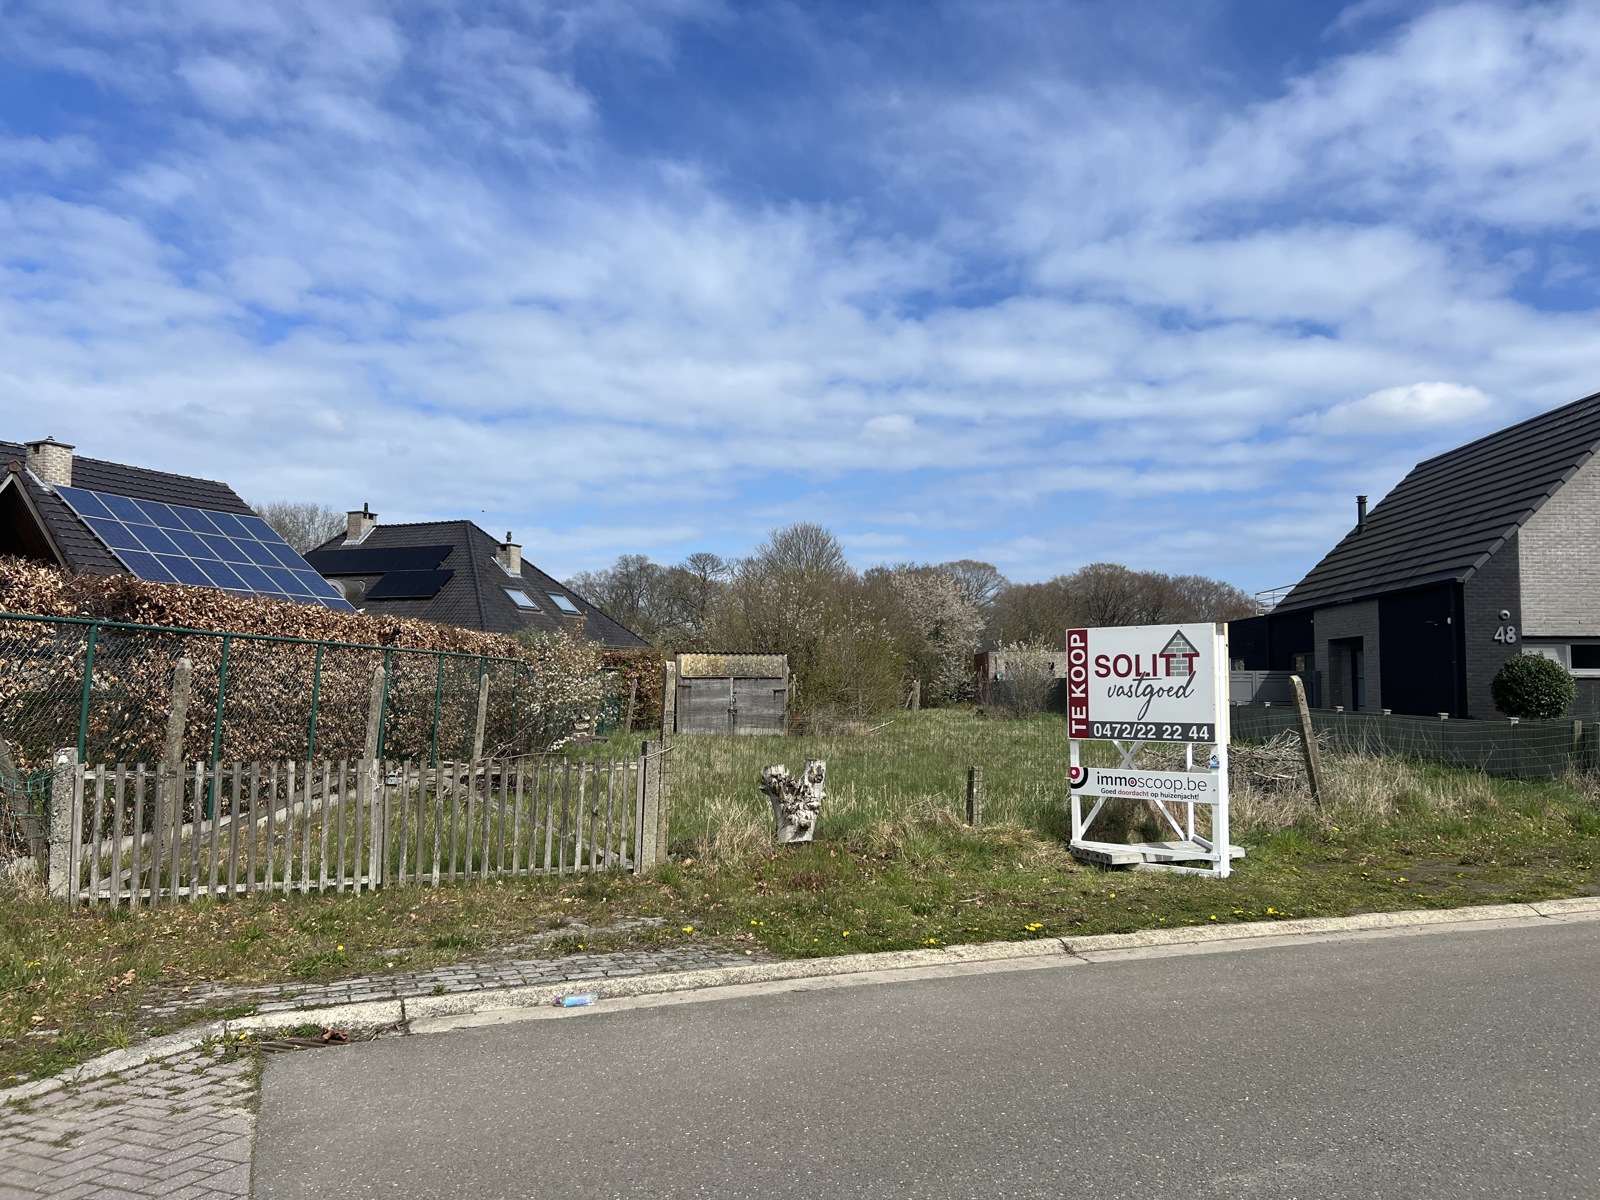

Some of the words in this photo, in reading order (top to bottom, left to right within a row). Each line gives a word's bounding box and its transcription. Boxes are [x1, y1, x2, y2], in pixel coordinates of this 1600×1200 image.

[1494, 625, 1517, 643] 48
[1070, 633, 1086, 698] KOOP
[1094, 653, 1200, 678] SOLITT
[1107, 670, 1197, 721] vastgoed
[1071, 706, 1087, 734] TE
[1093, 723, 1156, 739] 0472/22
[1162, 725, 1182, 739] 22
[1188, 725, 1209, 740] 44
[1096, 771, 1207, 793] immoscoop.be
[1117, 789, 1149, 797] doordacht
[1160, 791, 1200, 801] huizenjacht!
